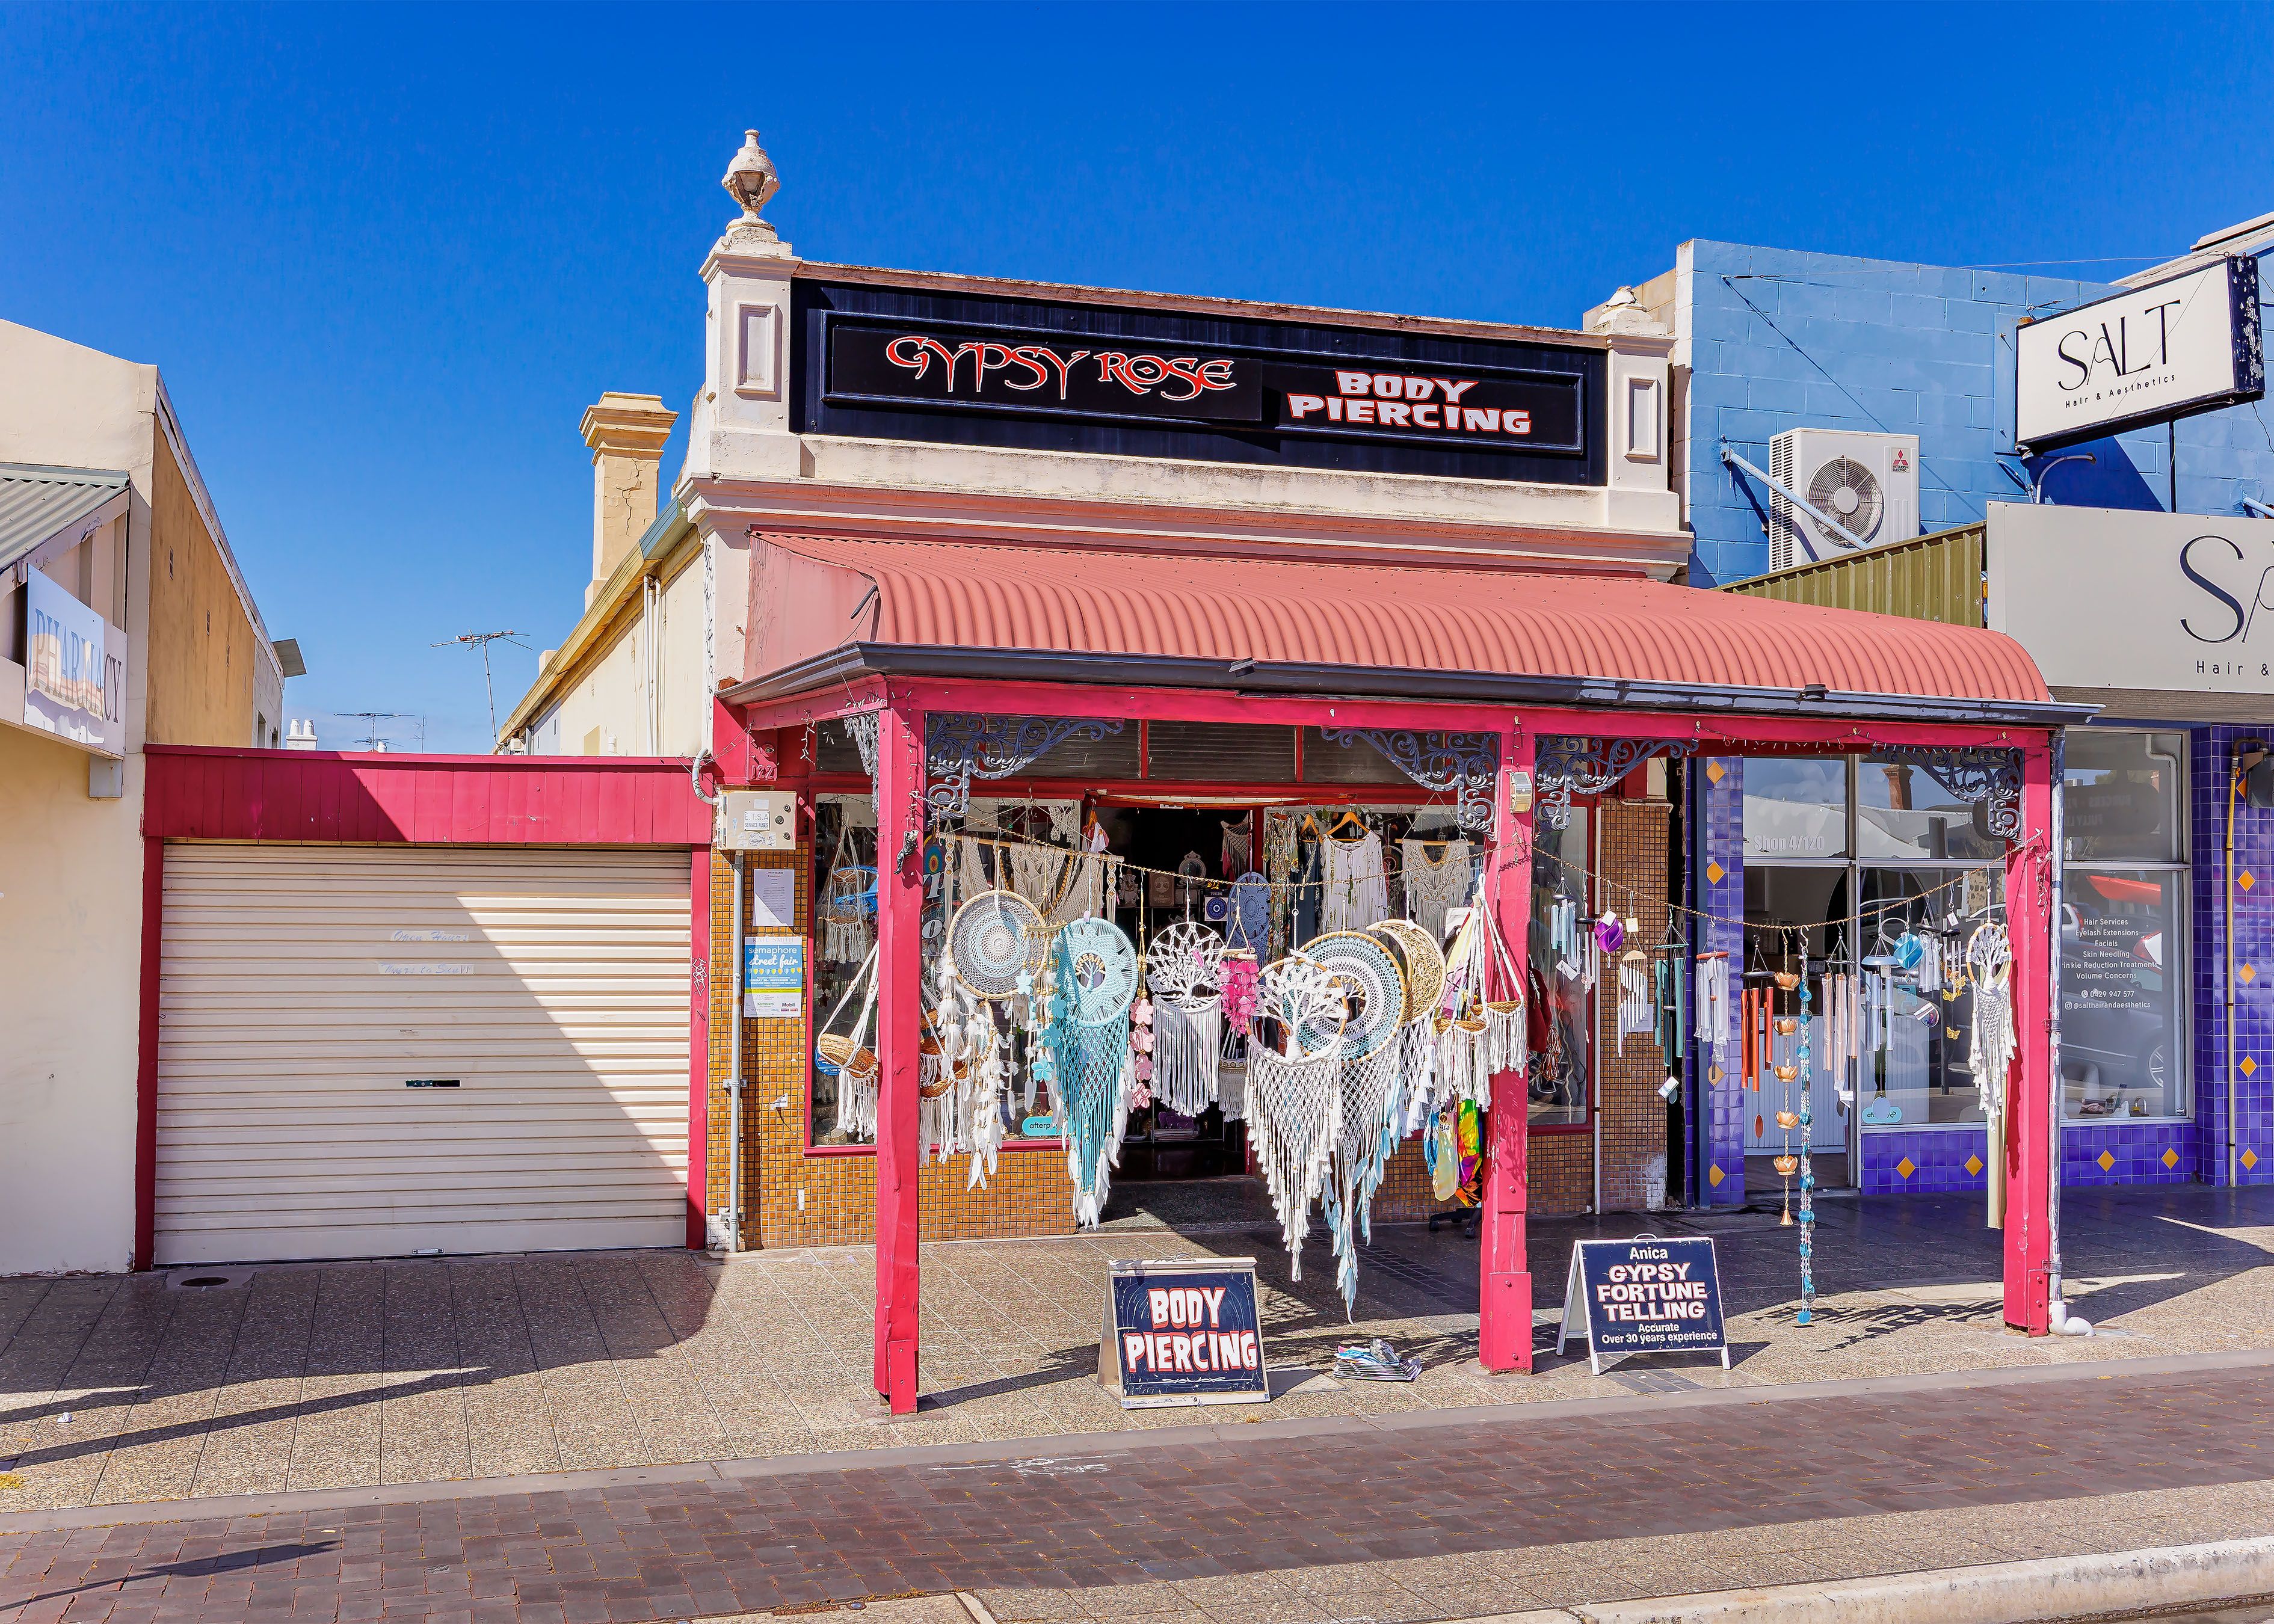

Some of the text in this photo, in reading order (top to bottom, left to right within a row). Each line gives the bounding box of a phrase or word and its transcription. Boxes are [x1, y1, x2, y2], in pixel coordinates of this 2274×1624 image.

[2058, 299, 2180, 391] SALT
[886, 336, 1236, 401] GYPSY ROSE
[1335, 371, 1478, 402] BODY
[2066, 396, 2089, 408] Hair
[2109, 374, 2176, 397] Aesthetics
[1287, 393, 1532, 434] PIERCING
[34, 608, 122, 724] PHARMACY
[2196, 660, 2270, 677] Hair &
[752, 764, 774, 780] 122
[1753, 834, 1825, 852] Shop 4/120
[748, 946, 798, 956] semaphore
[749, 954, 798, 968] street fair
[1630, 1247, 1668, 1260] Anica
[1609, 1262, 1691, 1282] GYPSY
[1597, 1281, 1708, 1302] FORTUNE
[1148, 1287, 1225, 1329] BODY
[1603, 1301, 1706, 1321] TELLING
[1638, 1323, 1680, 1333] Accurate
[1601, 1331, 1718, 1346] Over 30 years experience
[1123, 1330, 1258, 1373] PIERCING
